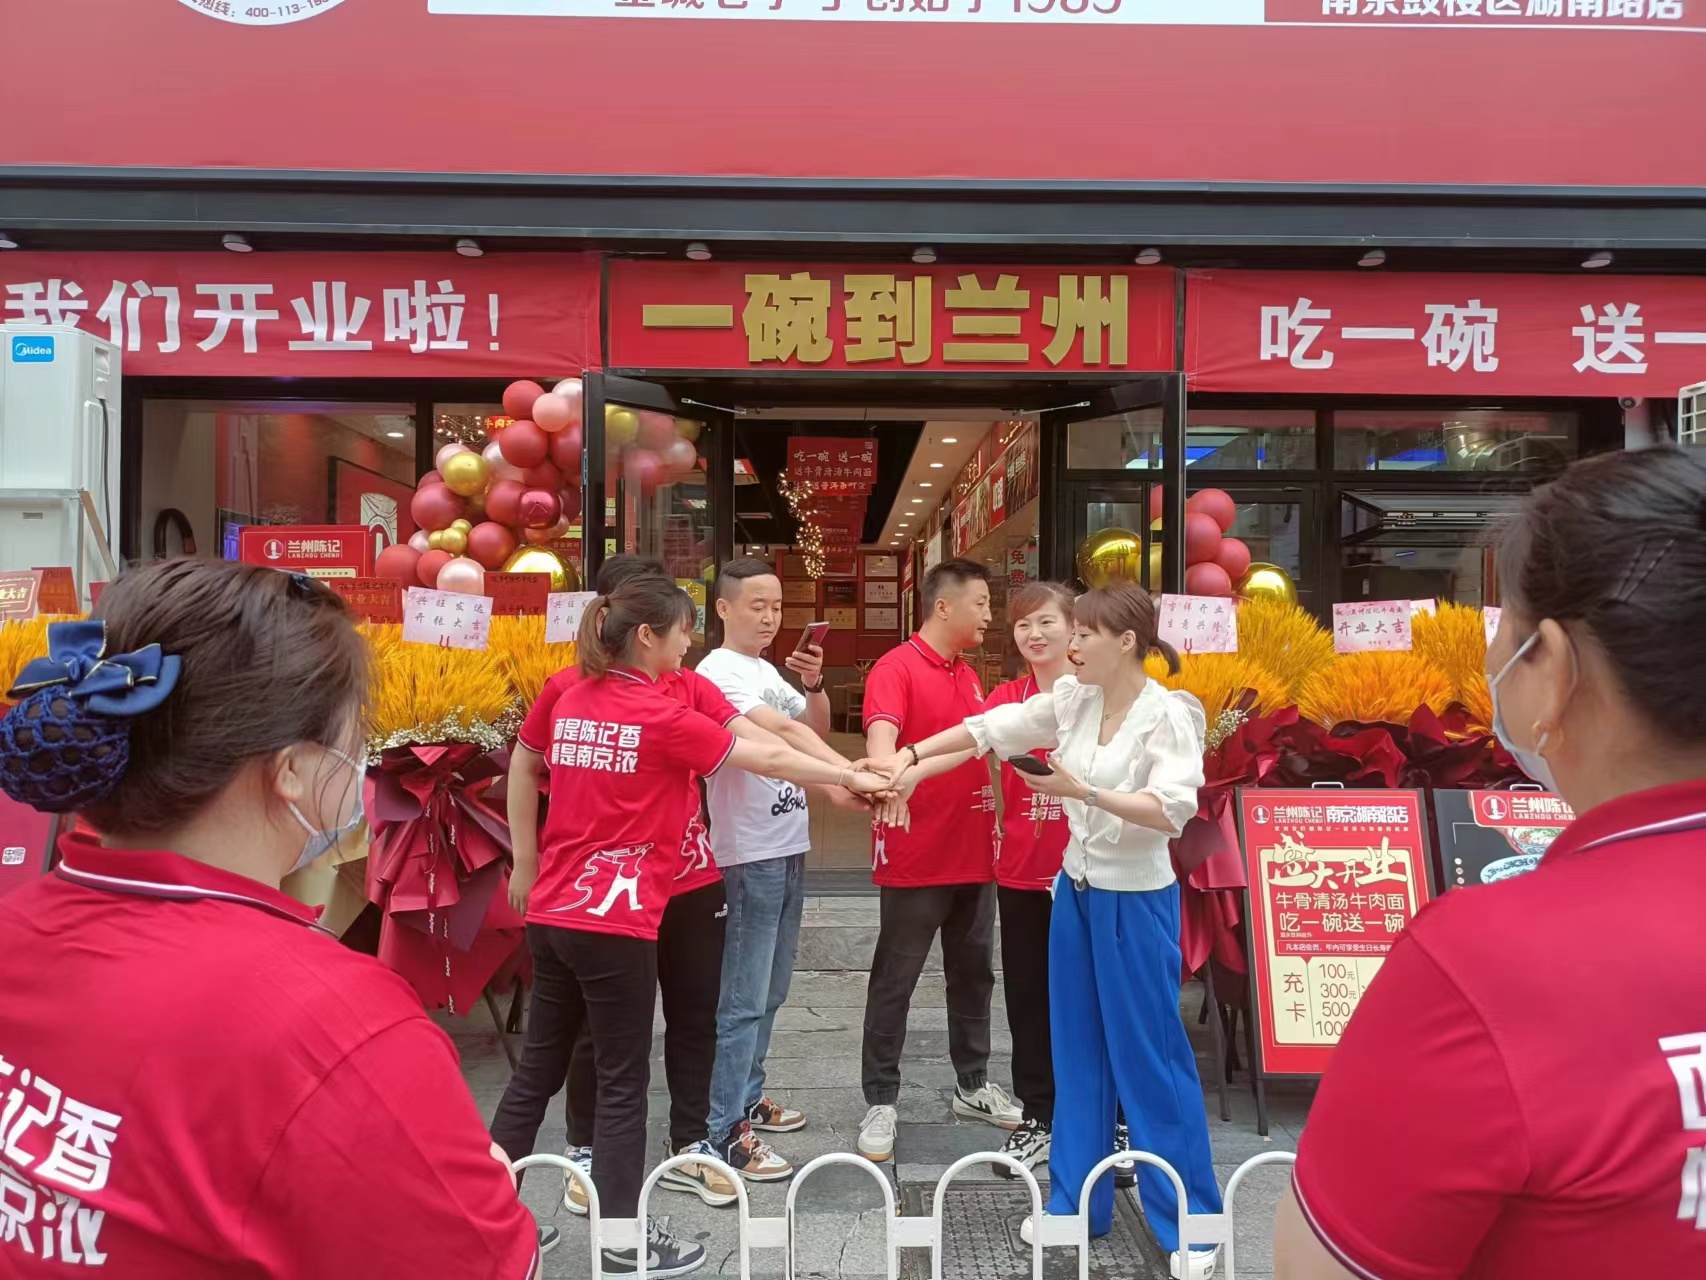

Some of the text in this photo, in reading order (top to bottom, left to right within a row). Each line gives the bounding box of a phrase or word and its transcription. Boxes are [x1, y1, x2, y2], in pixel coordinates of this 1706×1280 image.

[642, 271, 1129, 366] 一碗到兰州
[1260, 297, 1500, 373] 吃一碗
[20, 345, 53, 355] Midea
[287, 539, 341, 553] 兰州陈记
[1337, 618, 1406, 637] 开业大吉
[1273, 805, 1409, 824] 兰州陈记 南京湖南路店
[1267, 831, 1408, 890] 盛大开业
[1276, 892, 1405, 911] 牛骨清汤牛肉面
[1279, 912, 1405, 933] 吃一碗送一碗
[1318, 963, 1356, 980] 100元
[1320, 983, 1357, 1000] 300元
[0, 1054, 123, 1192] 记香
